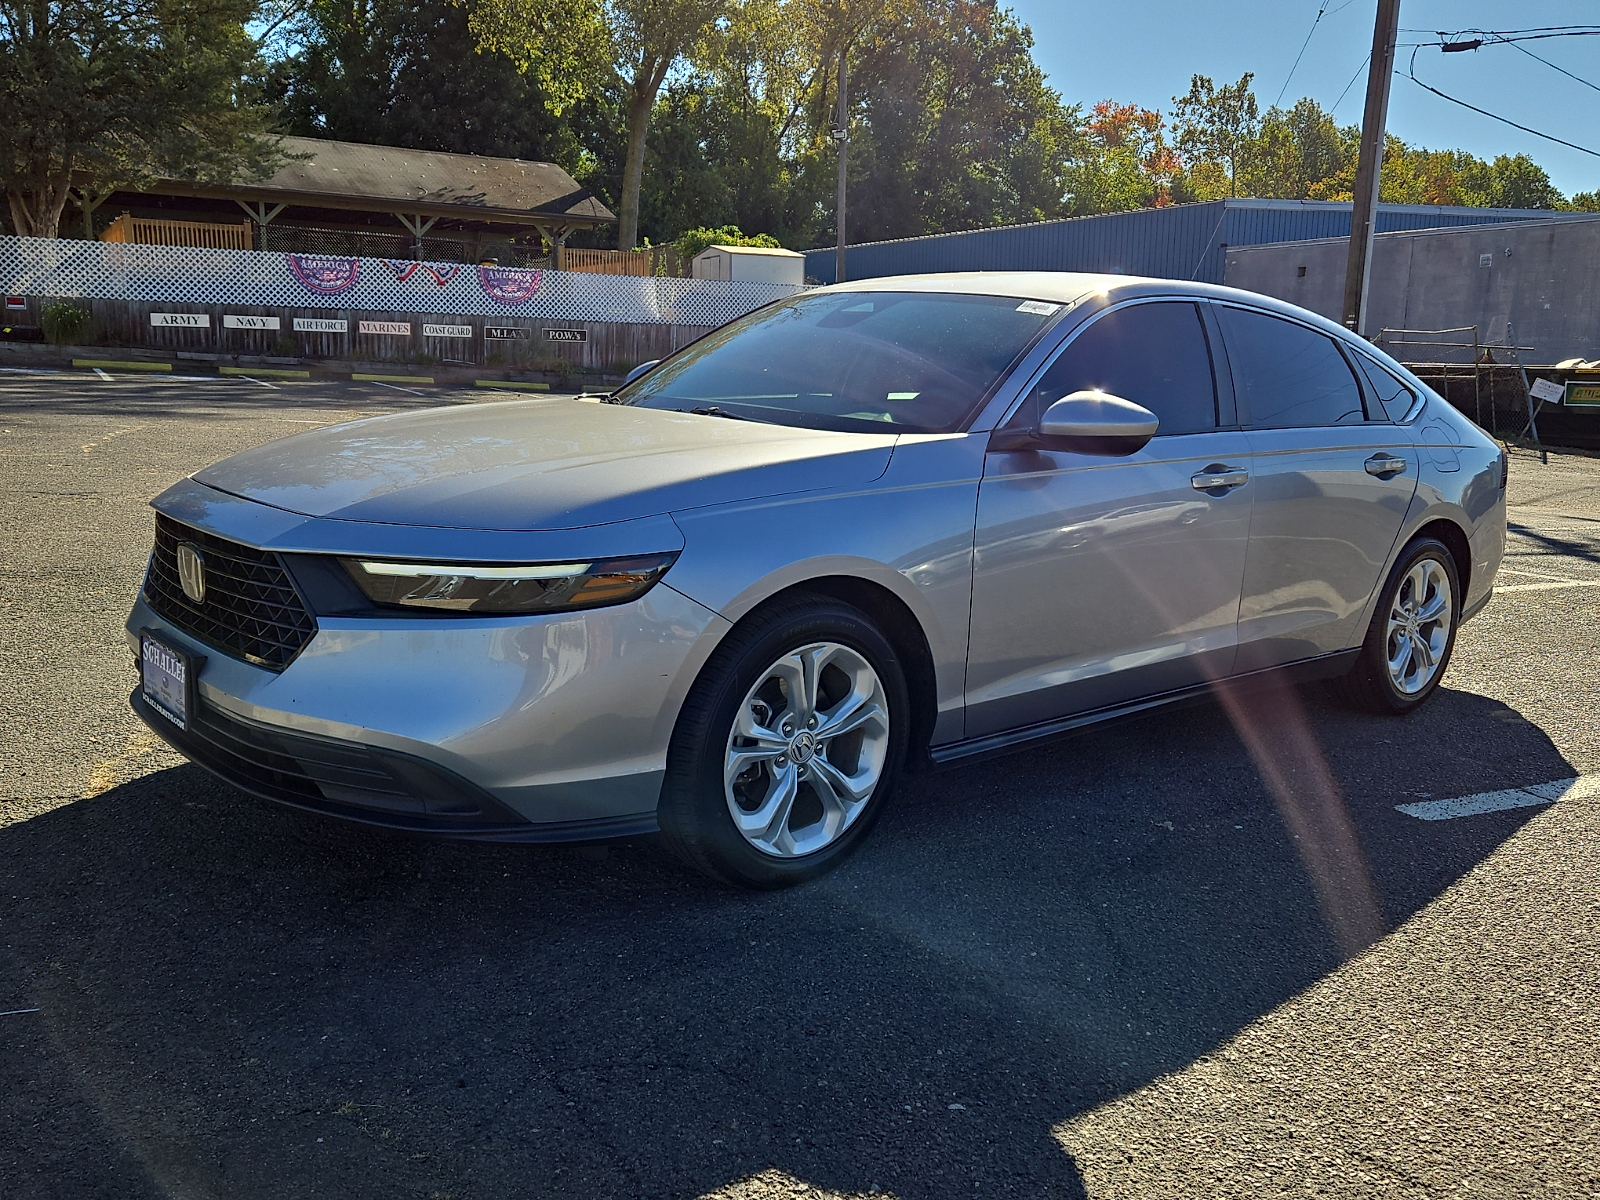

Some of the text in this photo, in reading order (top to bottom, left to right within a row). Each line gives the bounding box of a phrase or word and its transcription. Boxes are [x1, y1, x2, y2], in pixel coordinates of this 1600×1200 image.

[301, 259, 350, 270] AMERICA
[160, 315, 200, 325] ARMY
[236, 317, 268, 327] NAVY
[295, 320, 346, 331] AIR FORCE
[360, 322, 409, 333] MARINES
[424, 325, 470, 336] COAST GUARD
